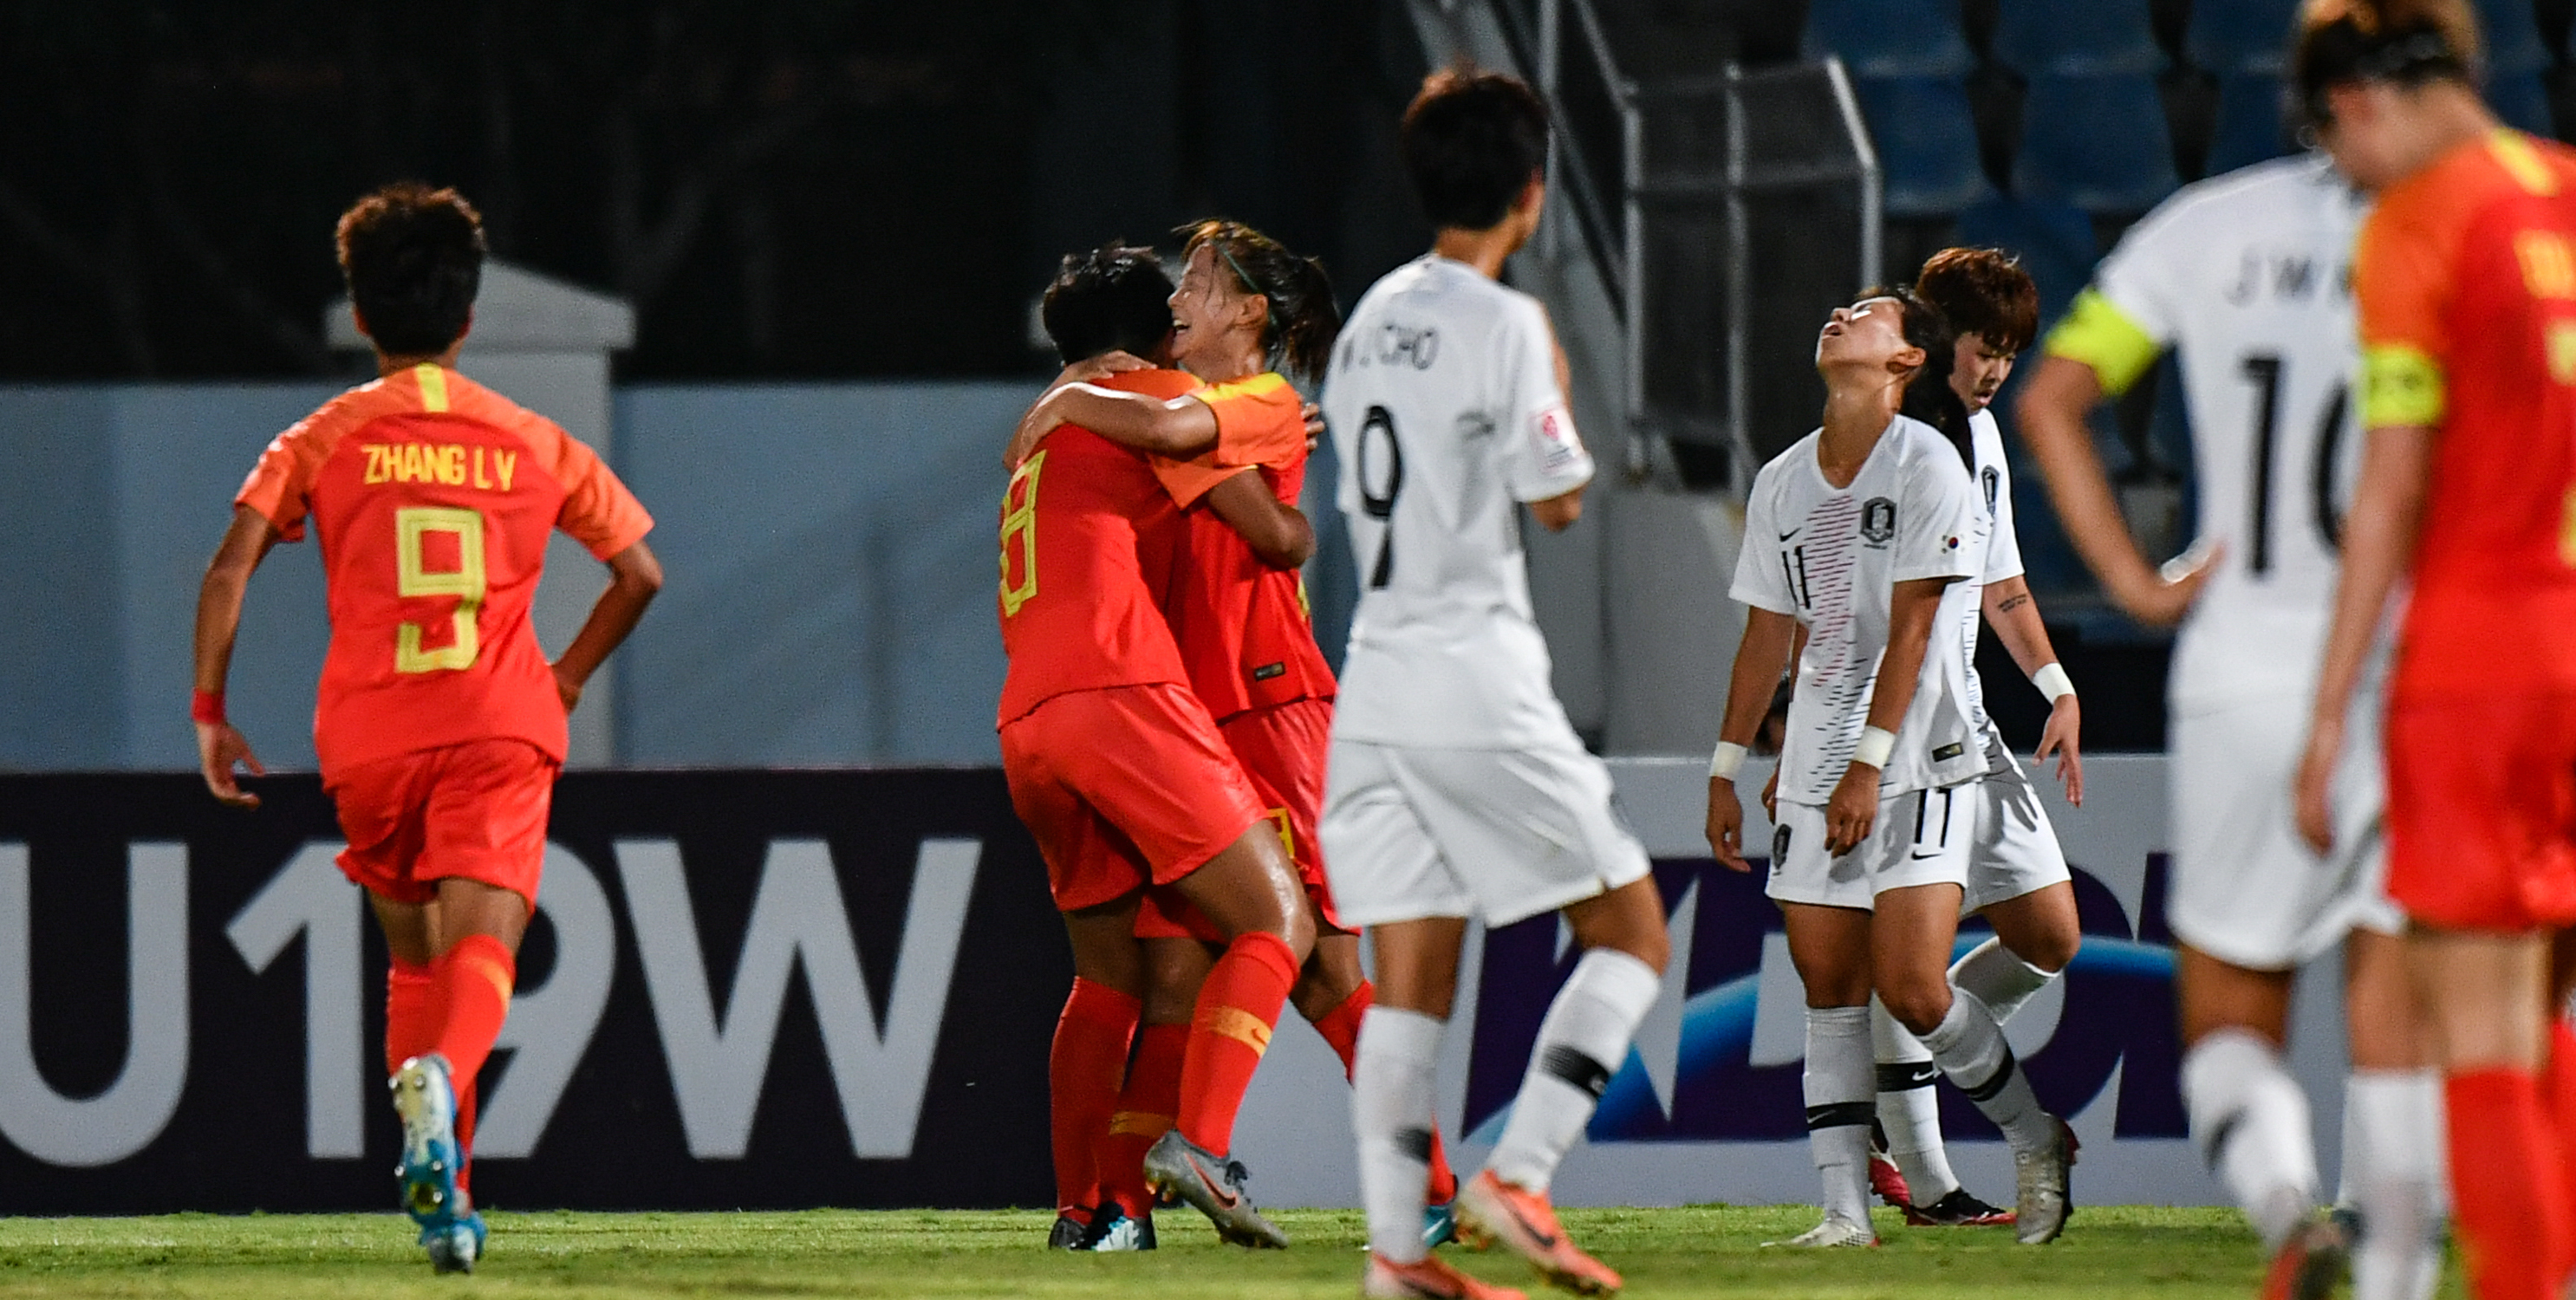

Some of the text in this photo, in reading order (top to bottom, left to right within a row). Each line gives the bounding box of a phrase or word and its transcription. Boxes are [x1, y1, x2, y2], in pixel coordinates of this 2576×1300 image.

[361, 443, 467, 486] ZHANG
[1357, 404, 1404, 590] 9
[396, 507, 486, 673] 9
[999, 448, 1048, 618] 8
[1781, 545, 1812, 611] 11
[1915, 786, 1952, 848] 11
